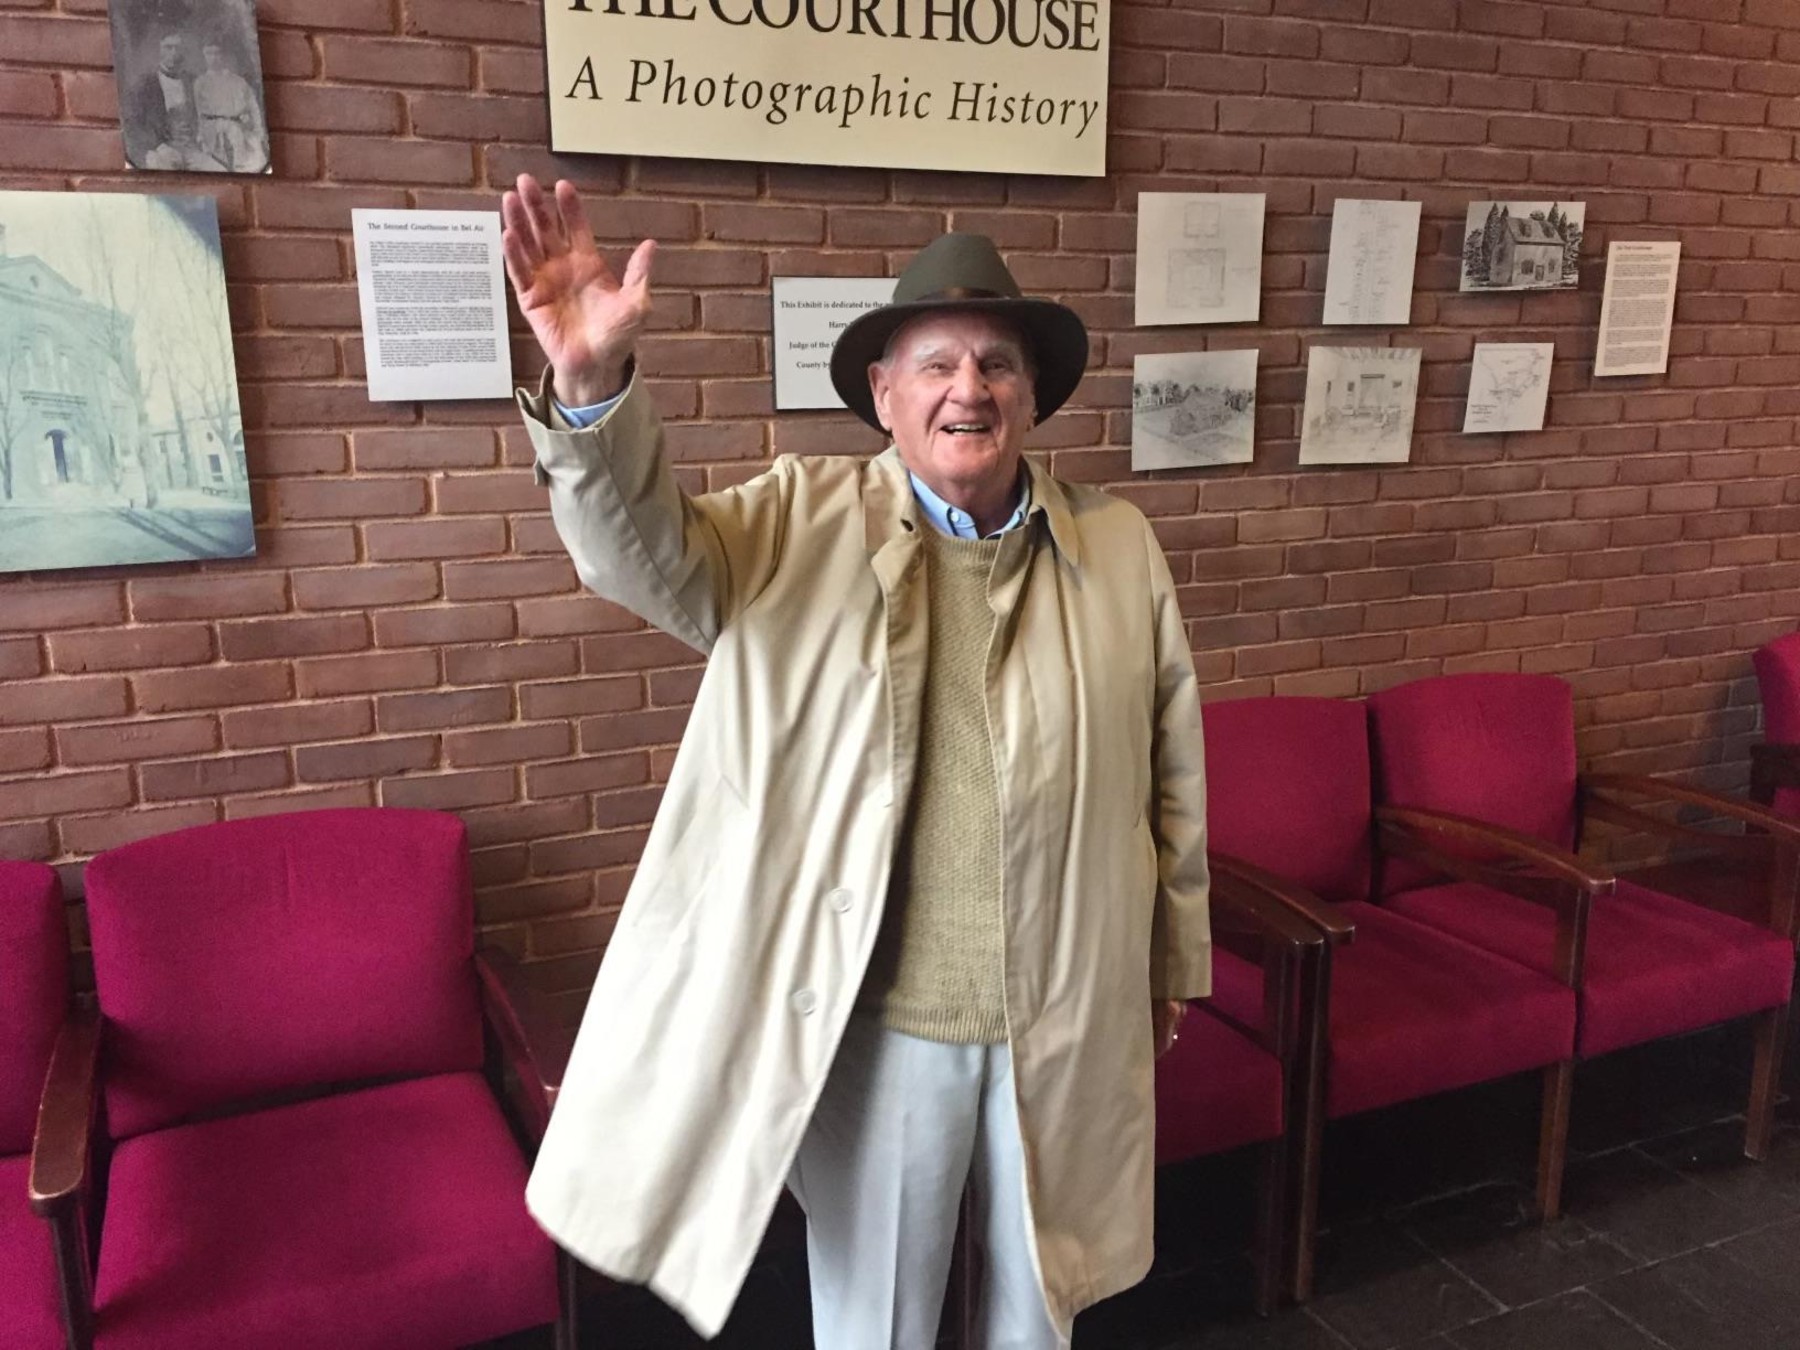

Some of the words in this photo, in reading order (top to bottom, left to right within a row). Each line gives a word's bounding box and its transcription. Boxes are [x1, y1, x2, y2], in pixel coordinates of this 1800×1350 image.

[564, 55, 603, 100] A
[624, 58, 932, 128] Photographic
[946, 81, 1099, 139] History
[781, 301, 796, 309] This
[797, 301, 822, 309] Exhibit
[824, 301, 830, 309] is
[831, 301, 863, 309] dedicated
[864, 301, 871, 309] to
[828, 321, 848, 329] Harry
[789, 342, 809, 350] Judge
[810, 341, 818, 349] of
[796, 361, 821, 370] County
